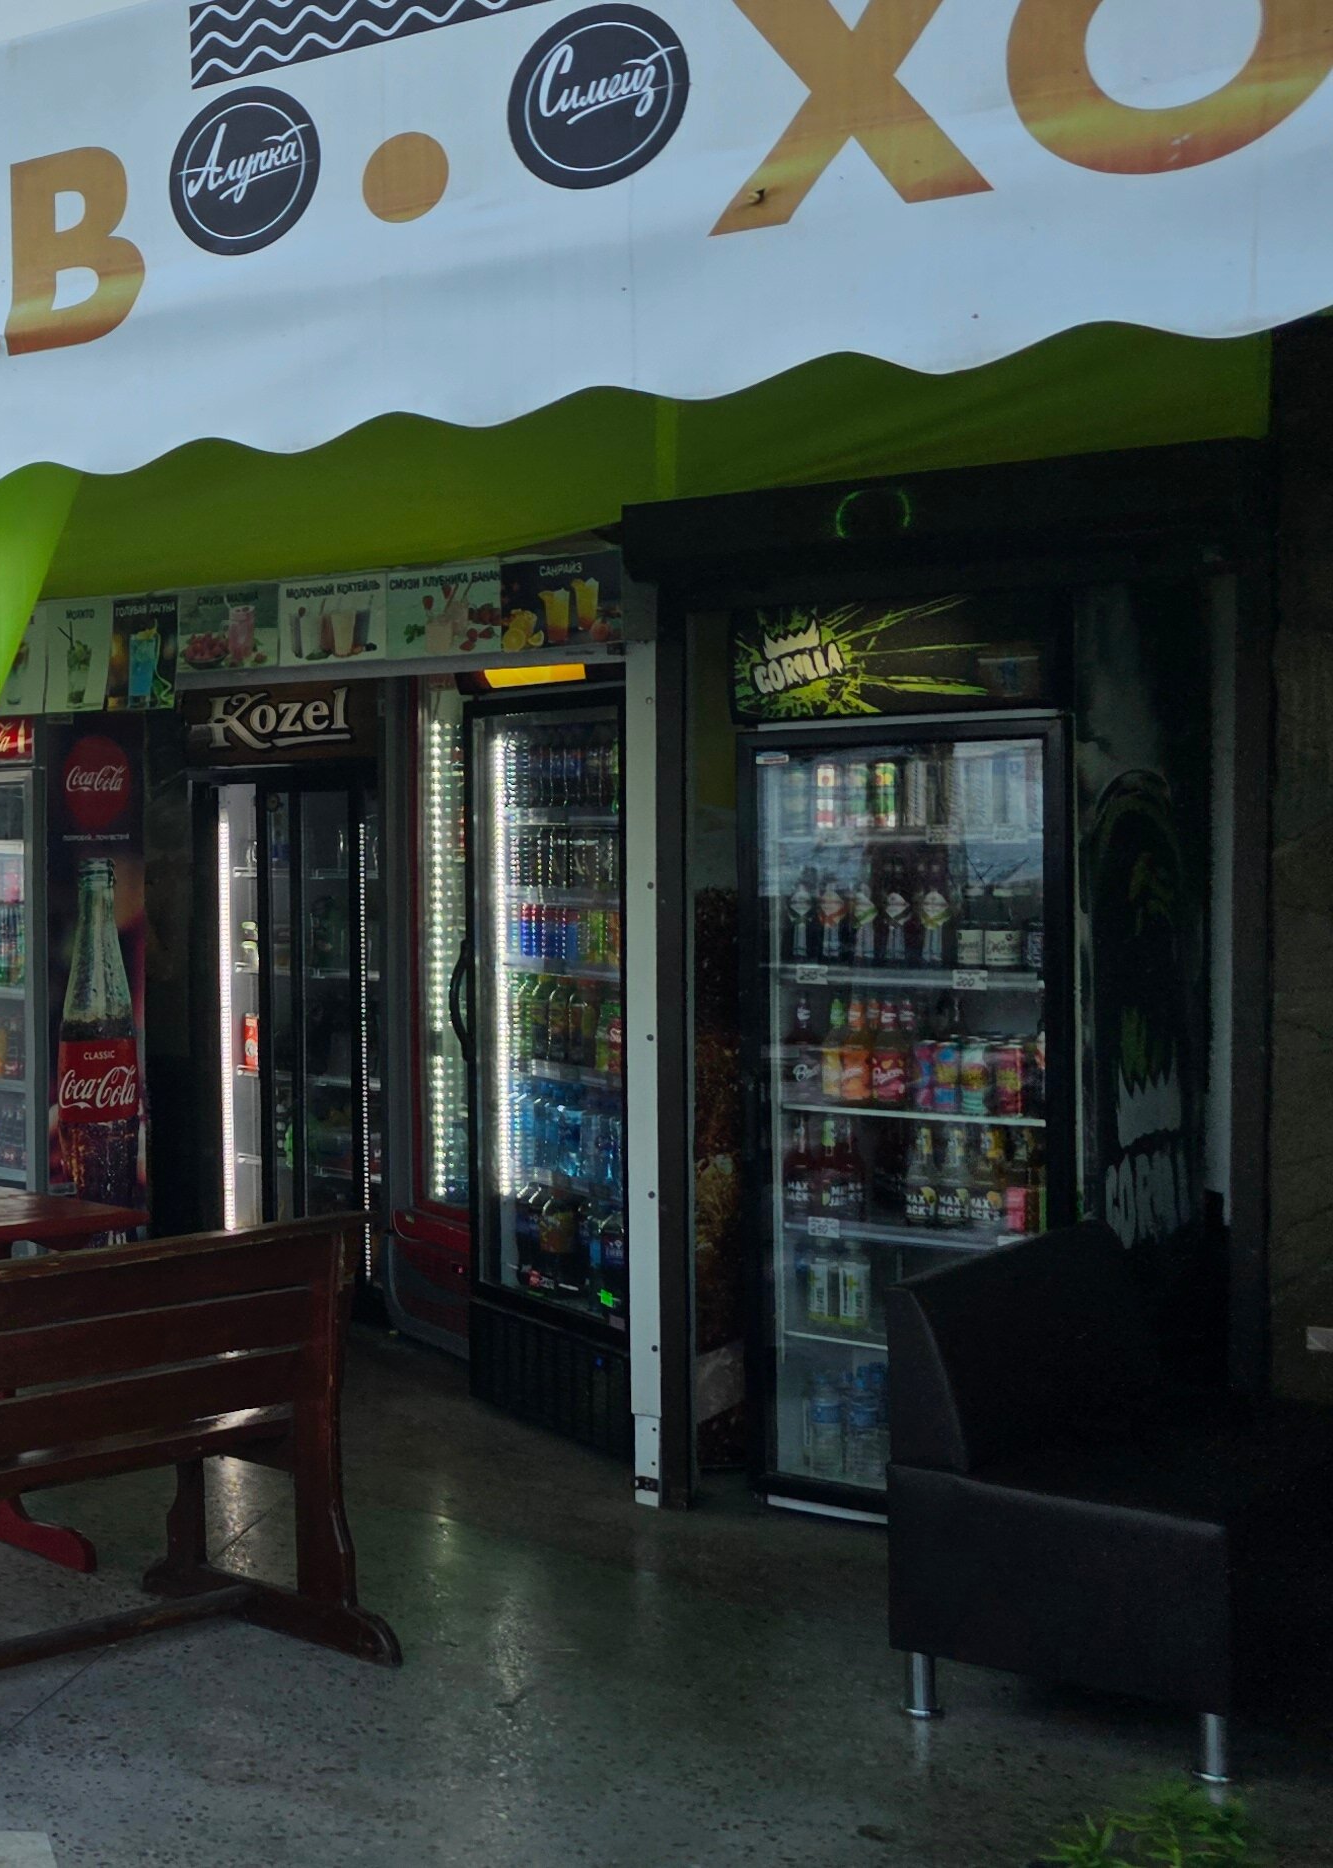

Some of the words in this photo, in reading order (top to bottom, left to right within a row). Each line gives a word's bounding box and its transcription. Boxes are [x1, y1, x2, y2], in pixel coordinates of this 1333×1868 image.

[539, 43, 656, 119] Симеиз
[182, 123, 300, 203] Алупка
[206, 686, 351, 749] Kozel
[83, 1050, 116, 1061] CLASSIC
